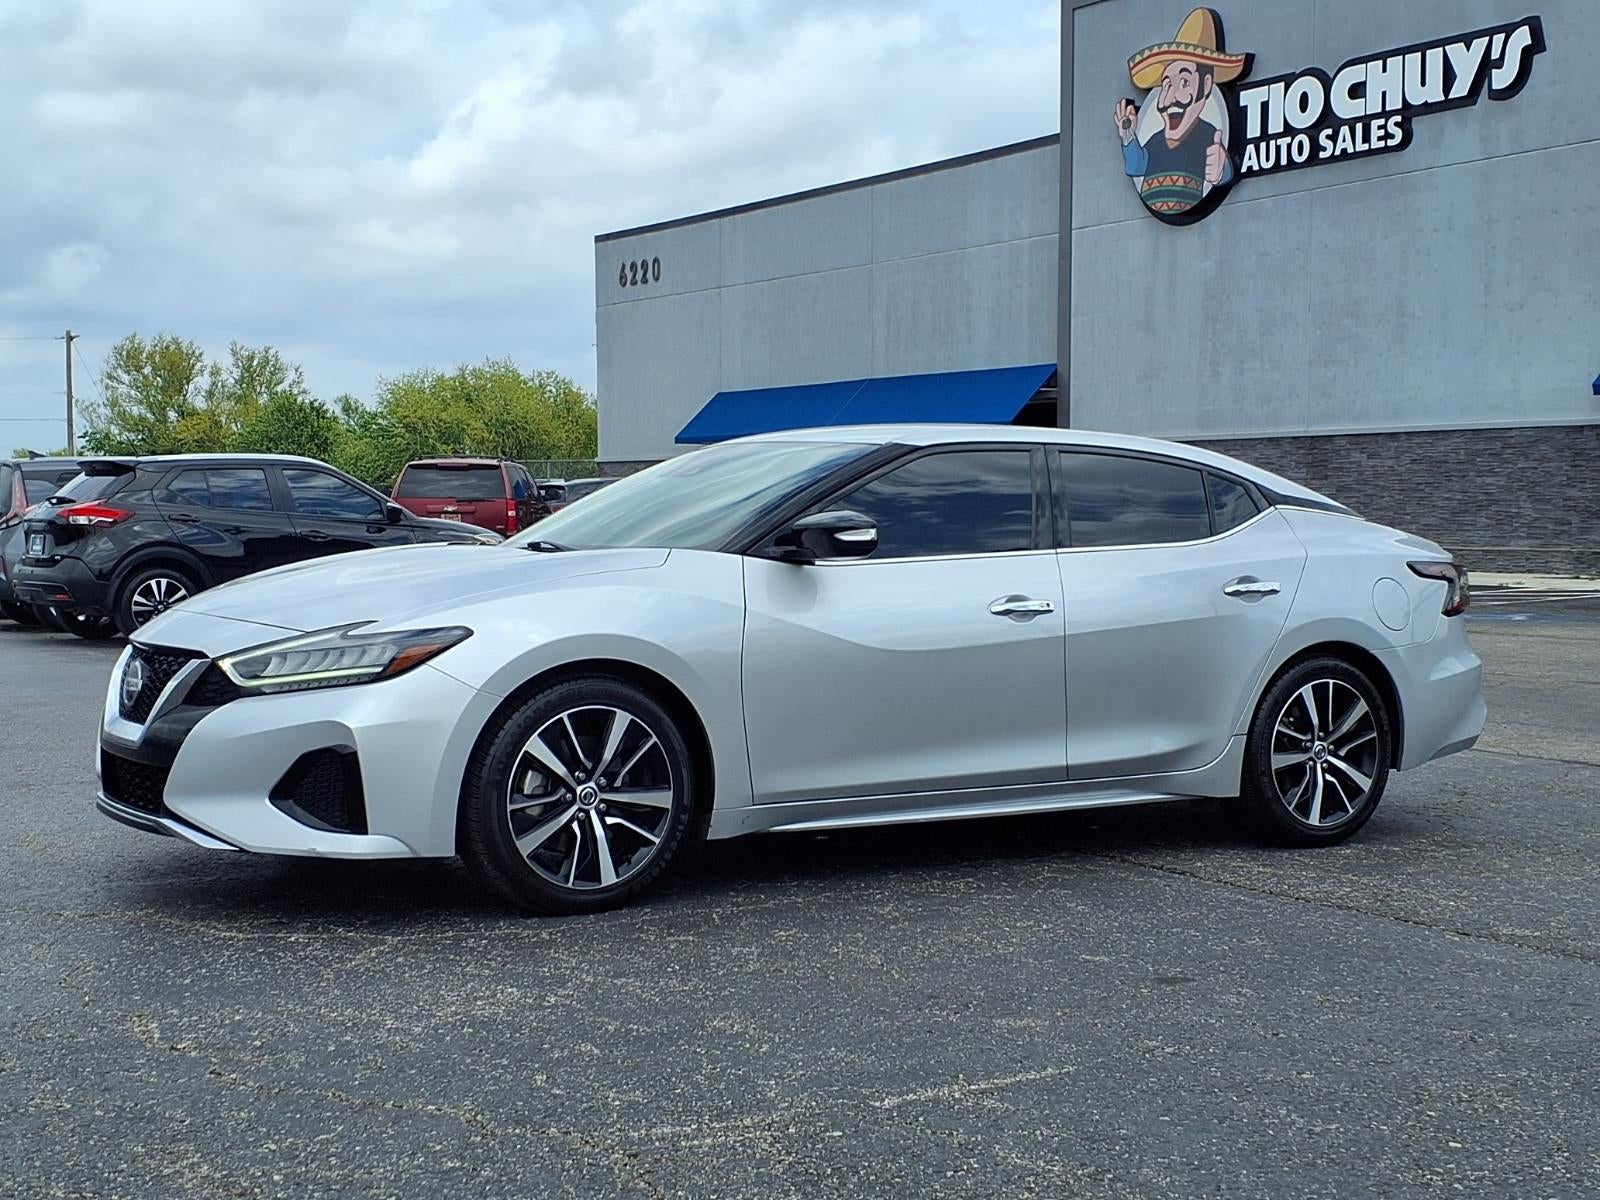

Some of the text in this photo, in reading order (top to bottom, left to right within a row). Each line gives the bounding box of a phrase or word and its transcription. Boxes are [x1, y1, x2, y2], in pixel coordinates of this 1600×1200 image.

[1239, 25, 1532, 139] TIO CHUY'S
[1240, 114, 1403, 173] AUTO SALES
[618, 256, 661, 288] 6220
